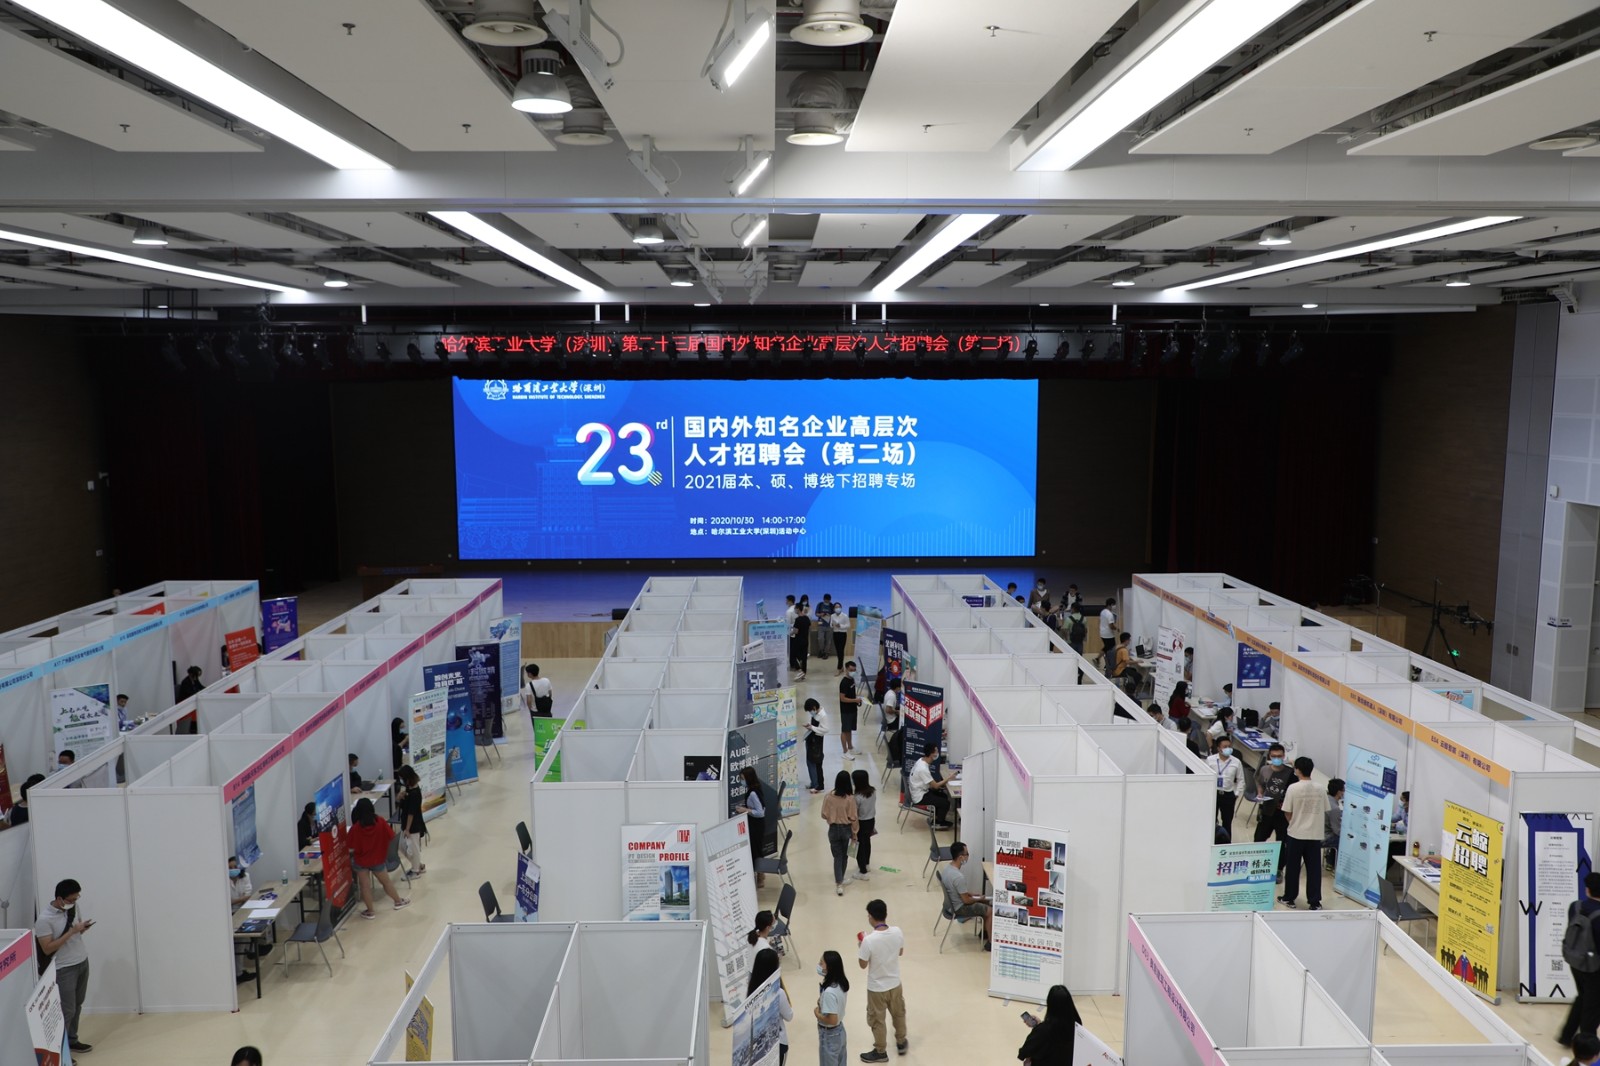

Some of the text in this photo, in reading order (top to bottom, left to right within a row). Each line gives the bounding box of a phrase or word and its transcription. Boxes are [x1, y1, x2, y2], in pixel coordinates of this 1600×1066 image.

[684, 415, 918, 438] 国内外知名企业高层次
[575, 422, 656, 486] 23
[684, 442, 917, 466] 人才招聘会（第二场）
[684, 473, 916, 490] 2021届本、硕、博线下招聘专场
[762, 516, 806, 524] 14:00-17:00
[729, 745, 750, 759] AUBE
[730, 755, 759, 772] 欧博设计
[628, 841, 666, 851] COMPANY
[1456, 822, 1489, 855] 云鲸
[659, 852, 690, 861] PROFILE
[1454, 843, 1488, 877] 招聘
[1217, 860, 1249, 876] 招聘
